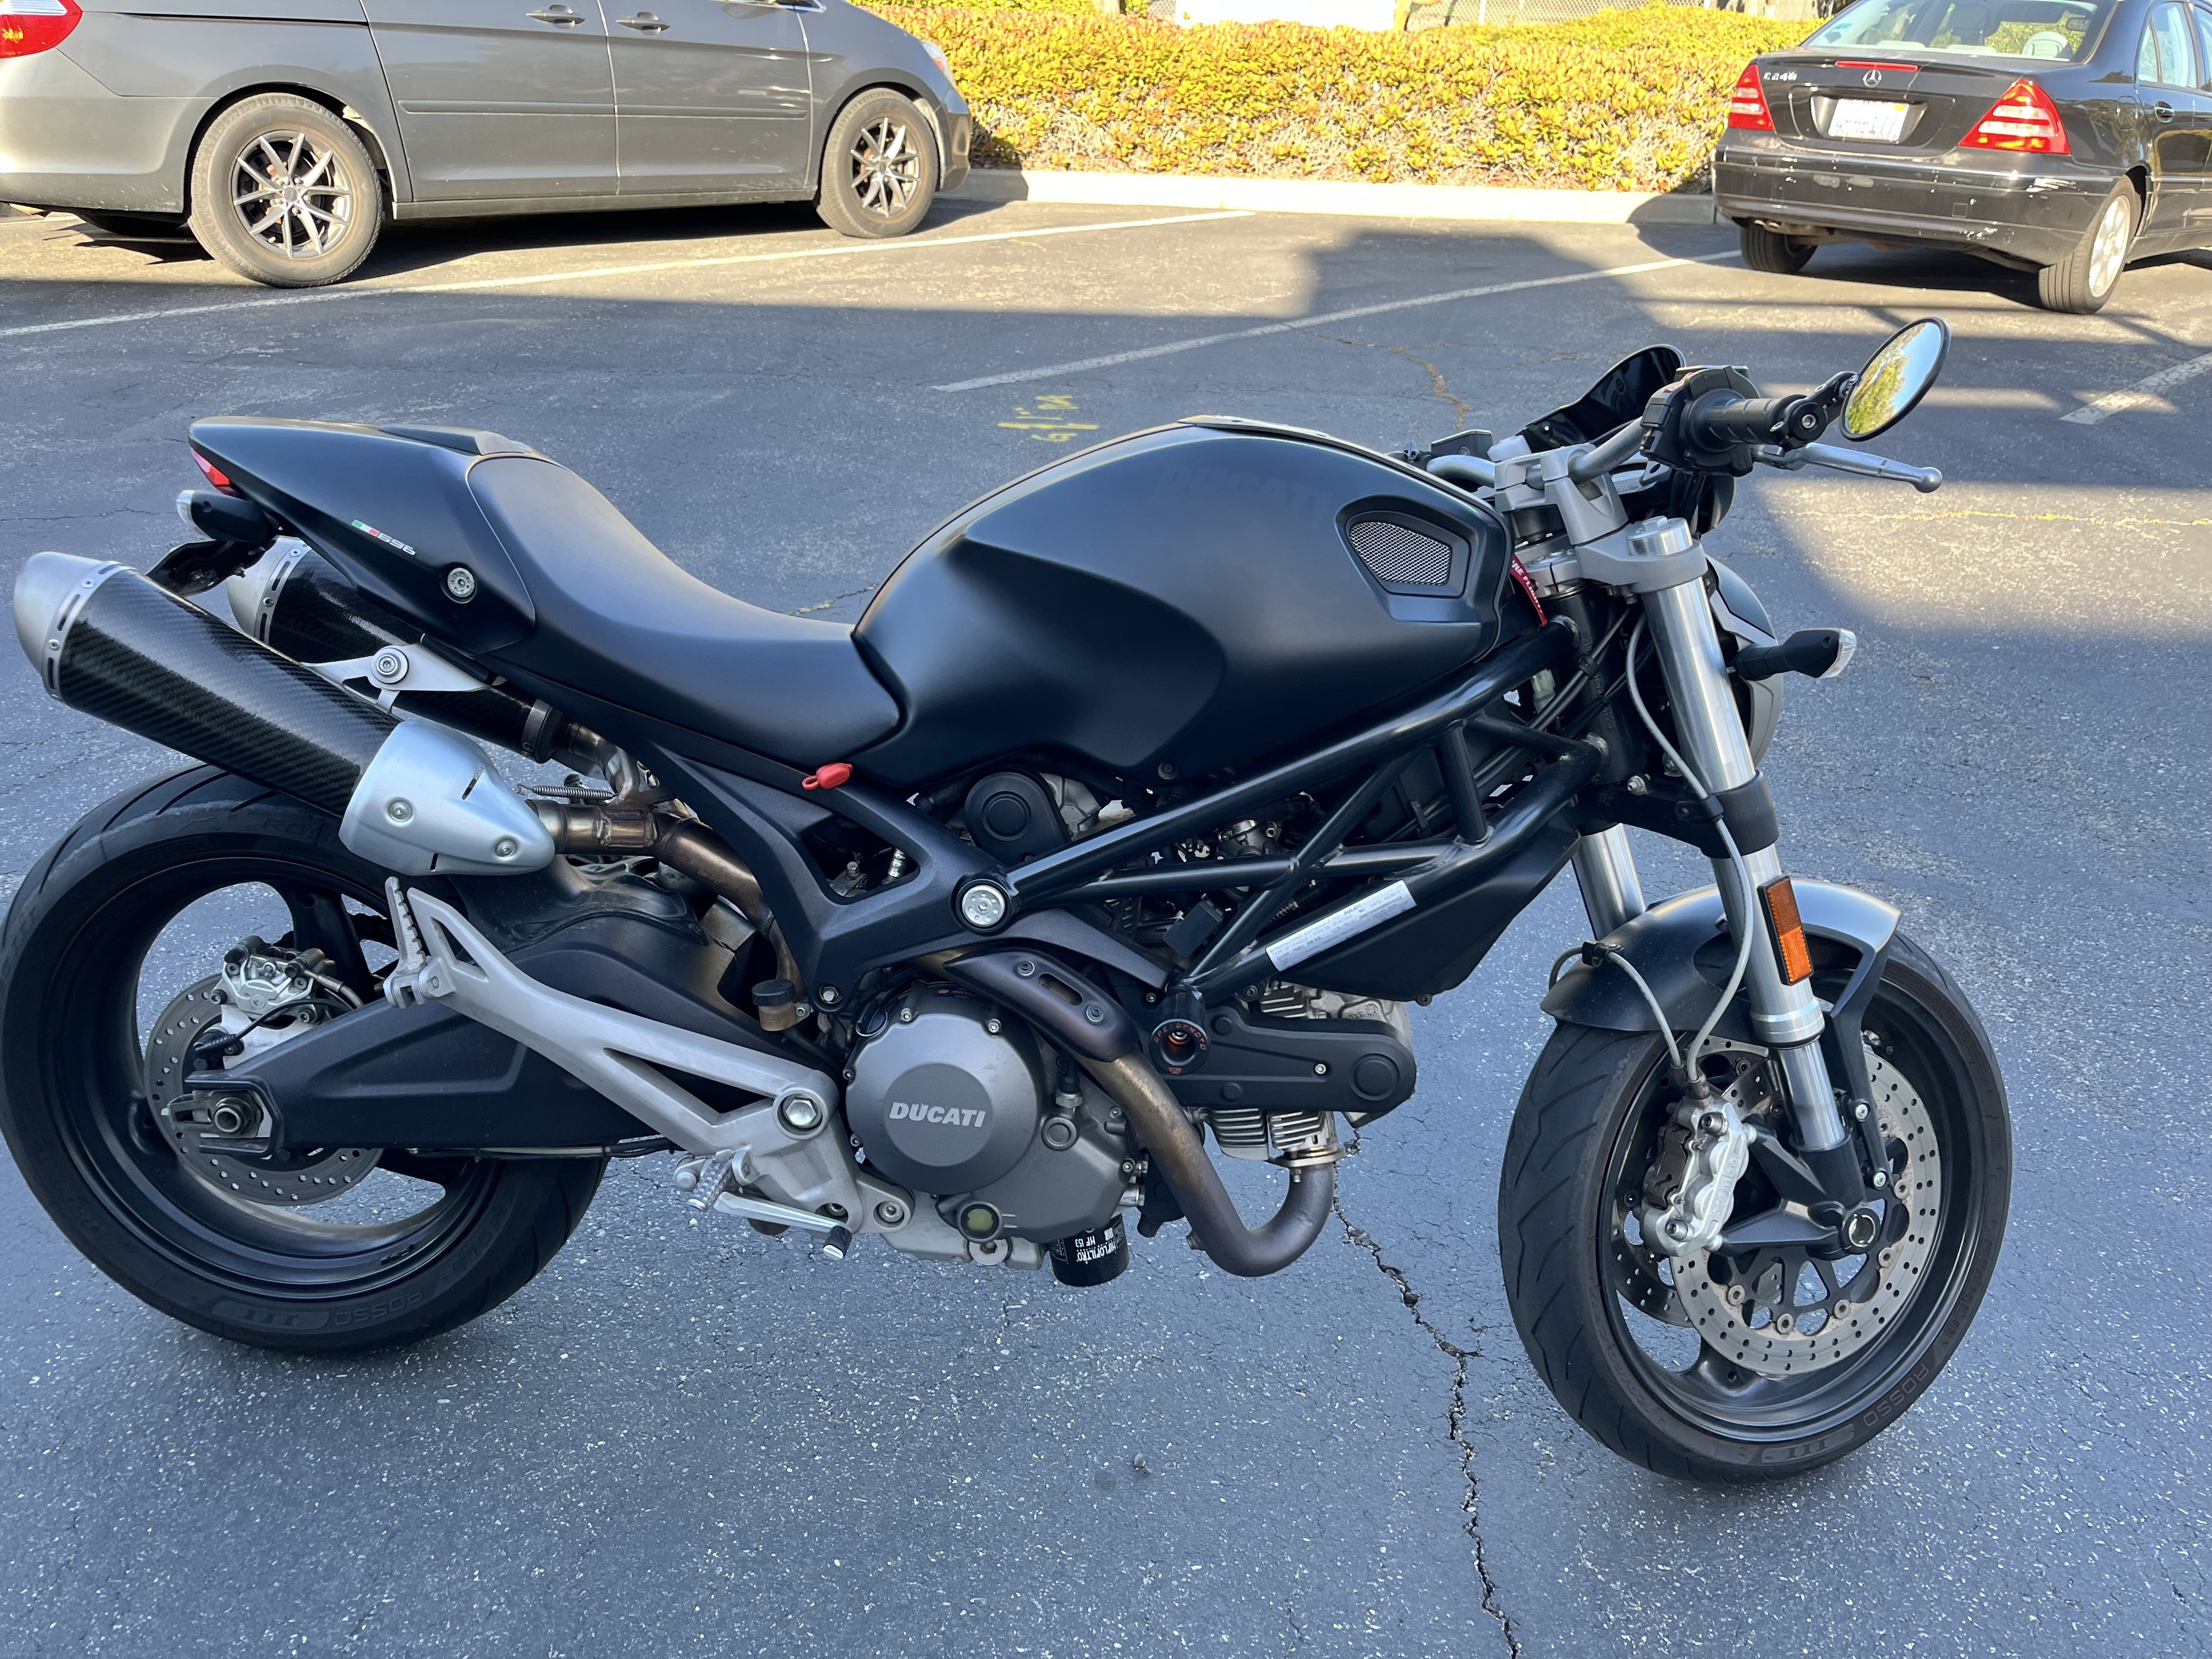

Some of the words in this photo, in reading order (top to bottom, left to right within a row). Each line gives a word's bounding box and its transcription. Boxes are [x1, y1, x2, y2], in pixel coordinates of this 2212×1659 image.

[377, 532, 416, 556] 696
[1154, 1023, 1206, 1051] SPEDYMOTO
[888, 1102, 986, 1128] DUCATI
[1077, 1240, 1116, 1262] HIFLOFILTRO
[1086, 1235, 1096, 1247] HF
[334, 1289, 424, 1327] ROSSO
[1863, 1363, 1929, 1427] ROSSO
[1786, 1438, 1829, 1459] III
